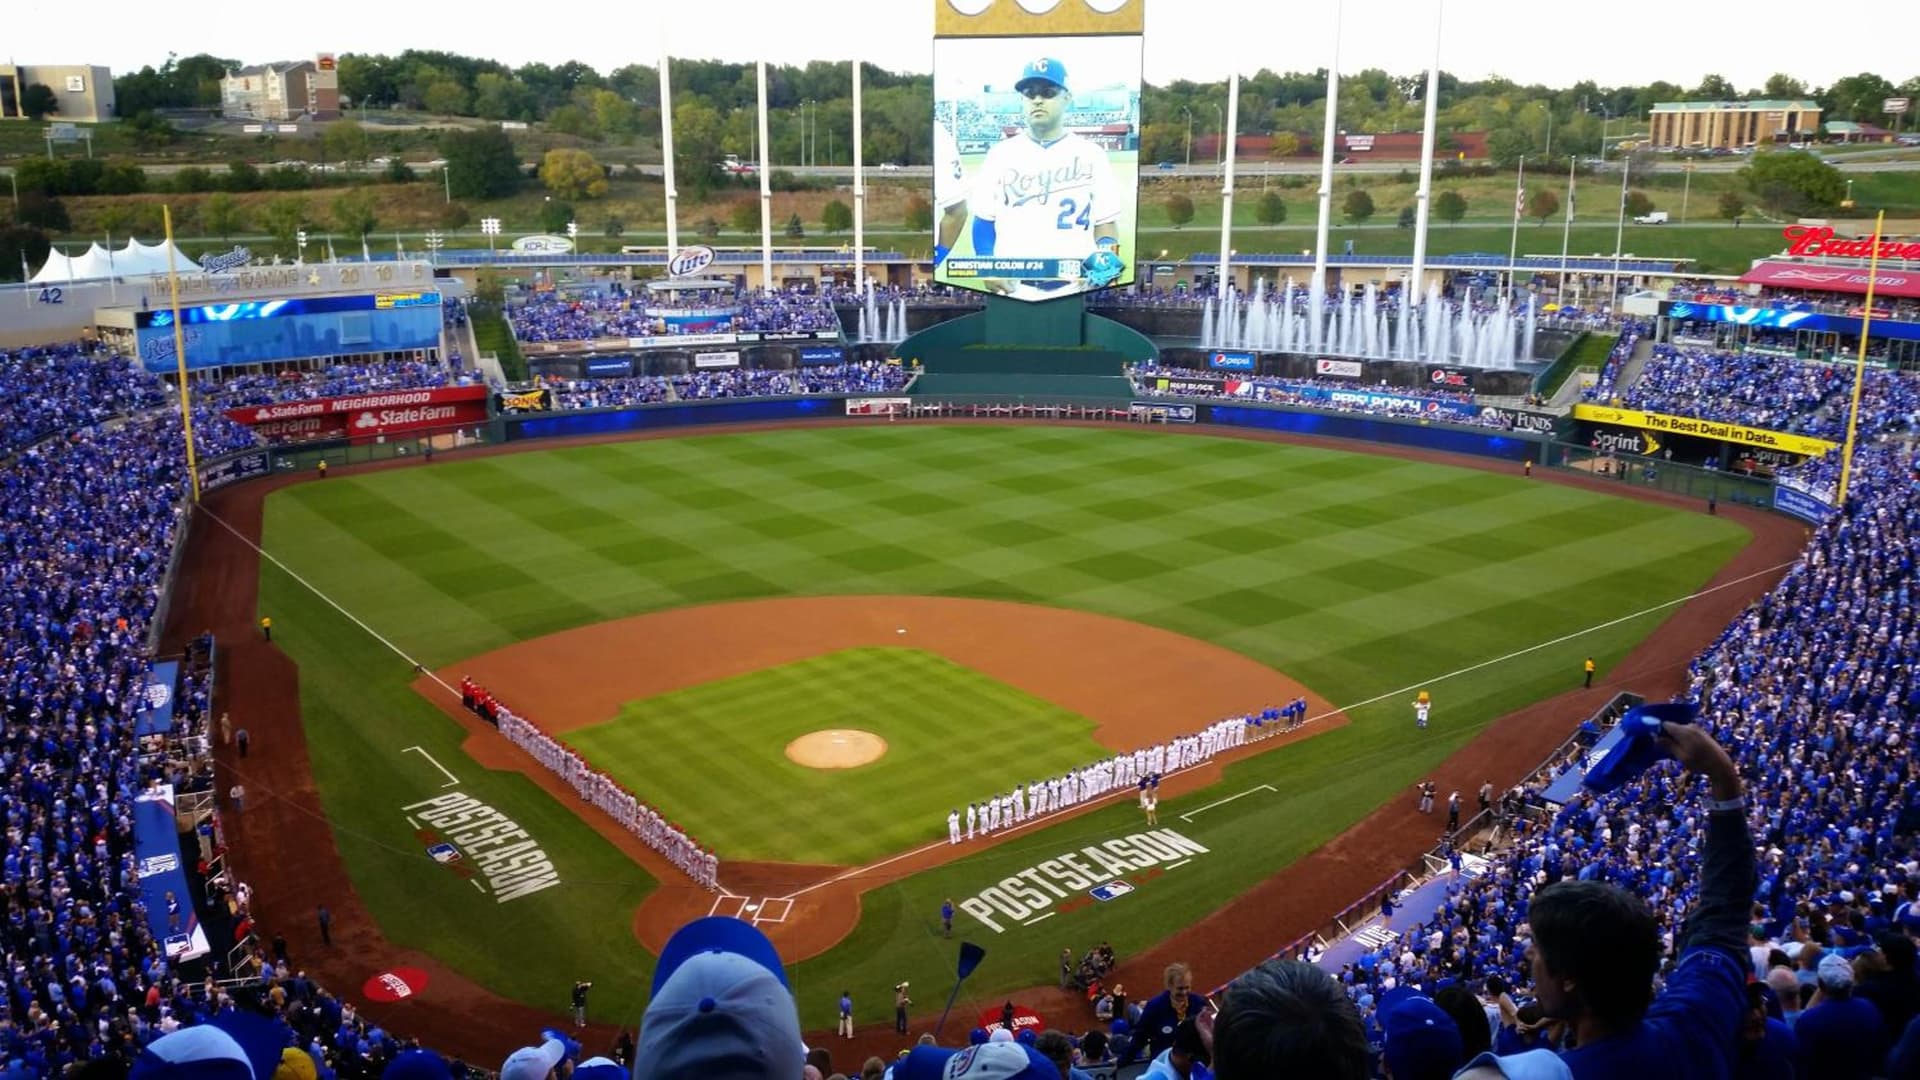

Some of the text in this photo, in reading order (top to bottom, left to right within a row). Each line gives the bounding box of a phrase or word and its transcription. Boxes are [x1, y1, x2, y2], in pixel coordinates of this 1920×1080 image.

[1001, 156, 1094, 206] Royals
[1056, 193, 1093, 232] 24
[199, 245, 251, 274] Royals
[680, 253, 709, 274] Lite
[948, 260, 1044, 270] CHRISTIAN COLON #24
[341, 267, 360, 284] 20
[376, 264, 393, 281] 10
[38, 287, 63, 304] 42
[1225, 357, 1250, 367] pepsi
[1188, 383, 1215, 391] BLOCK
[332, 392, 431, 411] NEIGHBORHOOD
[504, 397, 543, 408] SONIC
[1331, 392, 1421, 413] PEPSI PORCH
[1516, 411, 1553, 431] FUNDS
[1645, 415, 1667, 429] The
[1670, 418, 1698, 433] Best
[1700, 423, 1729, 438] Deal
[1731, 427, 1743, 440] in
[1746, 430, 1778, 446] Data.
[1592, 430, 1641, 453] Sprint
[1751, 446, 1791, 465] Sprint
[402, 792, 560, 904] POSTSEASON
[959, 828, 1211, 934] POSTSEASON
